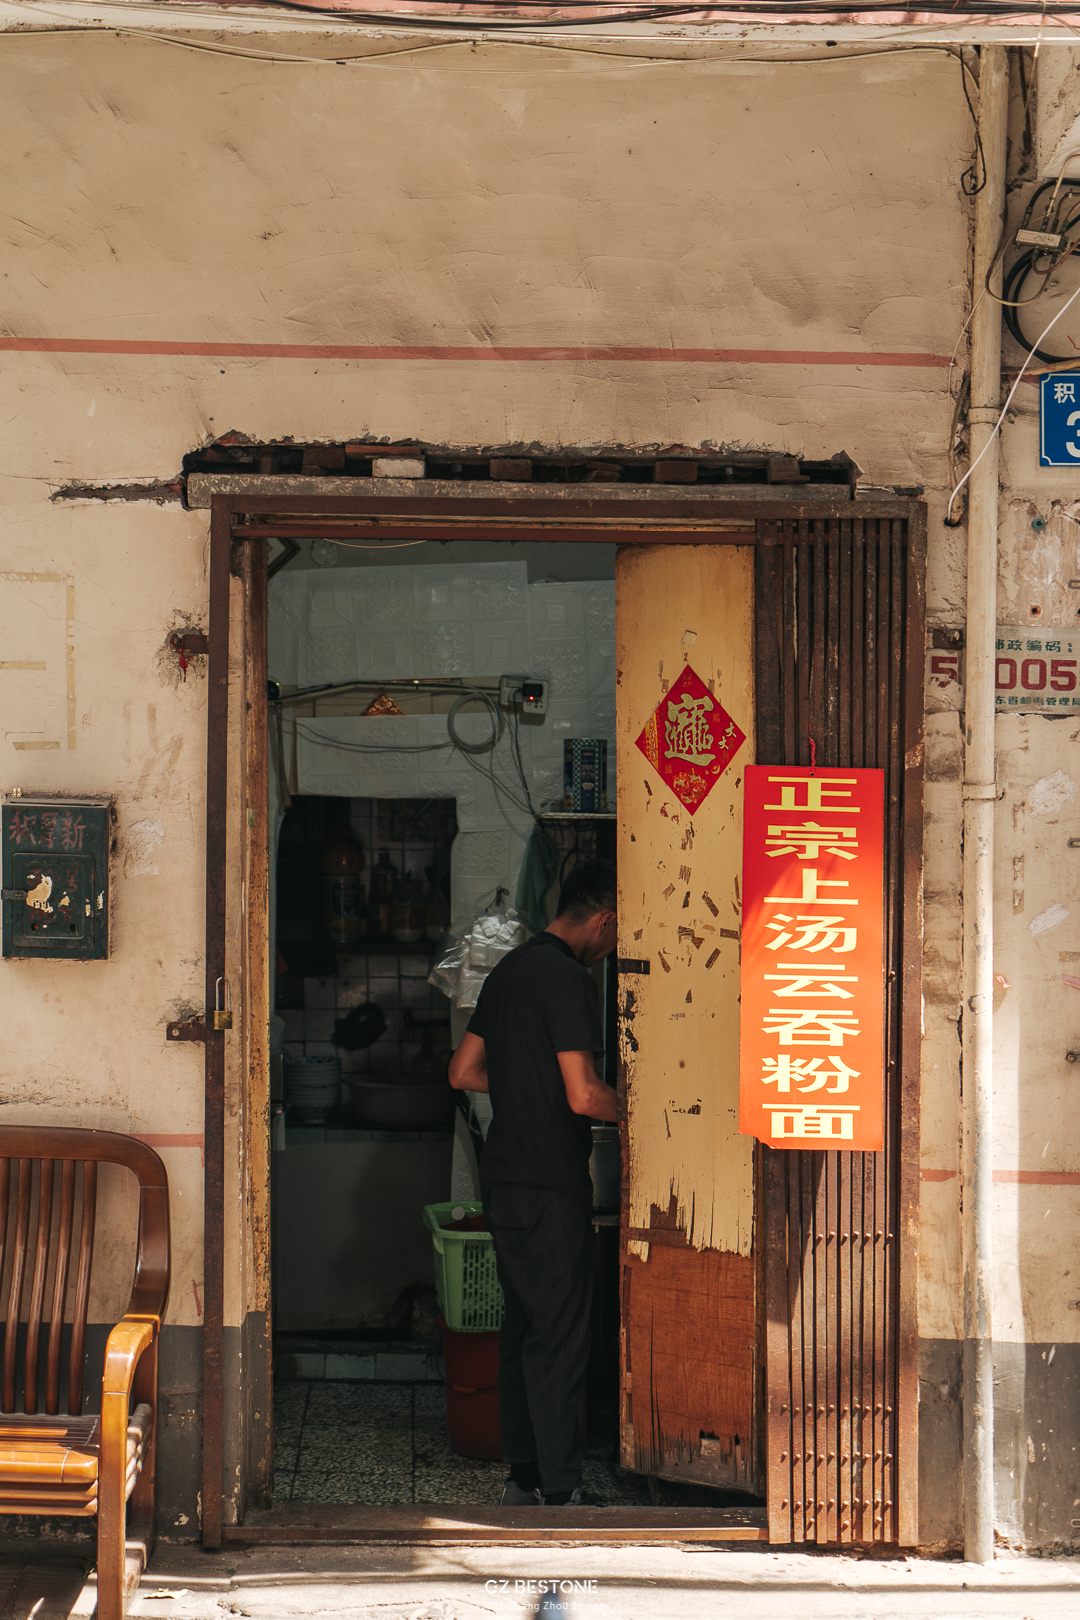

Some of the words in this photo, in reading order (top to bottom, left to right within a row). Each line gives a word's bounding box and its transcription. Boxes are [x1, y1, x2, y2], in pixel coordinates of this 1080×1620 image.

[761, 776, 861, 1140] 正宗上汤云吞粉面
